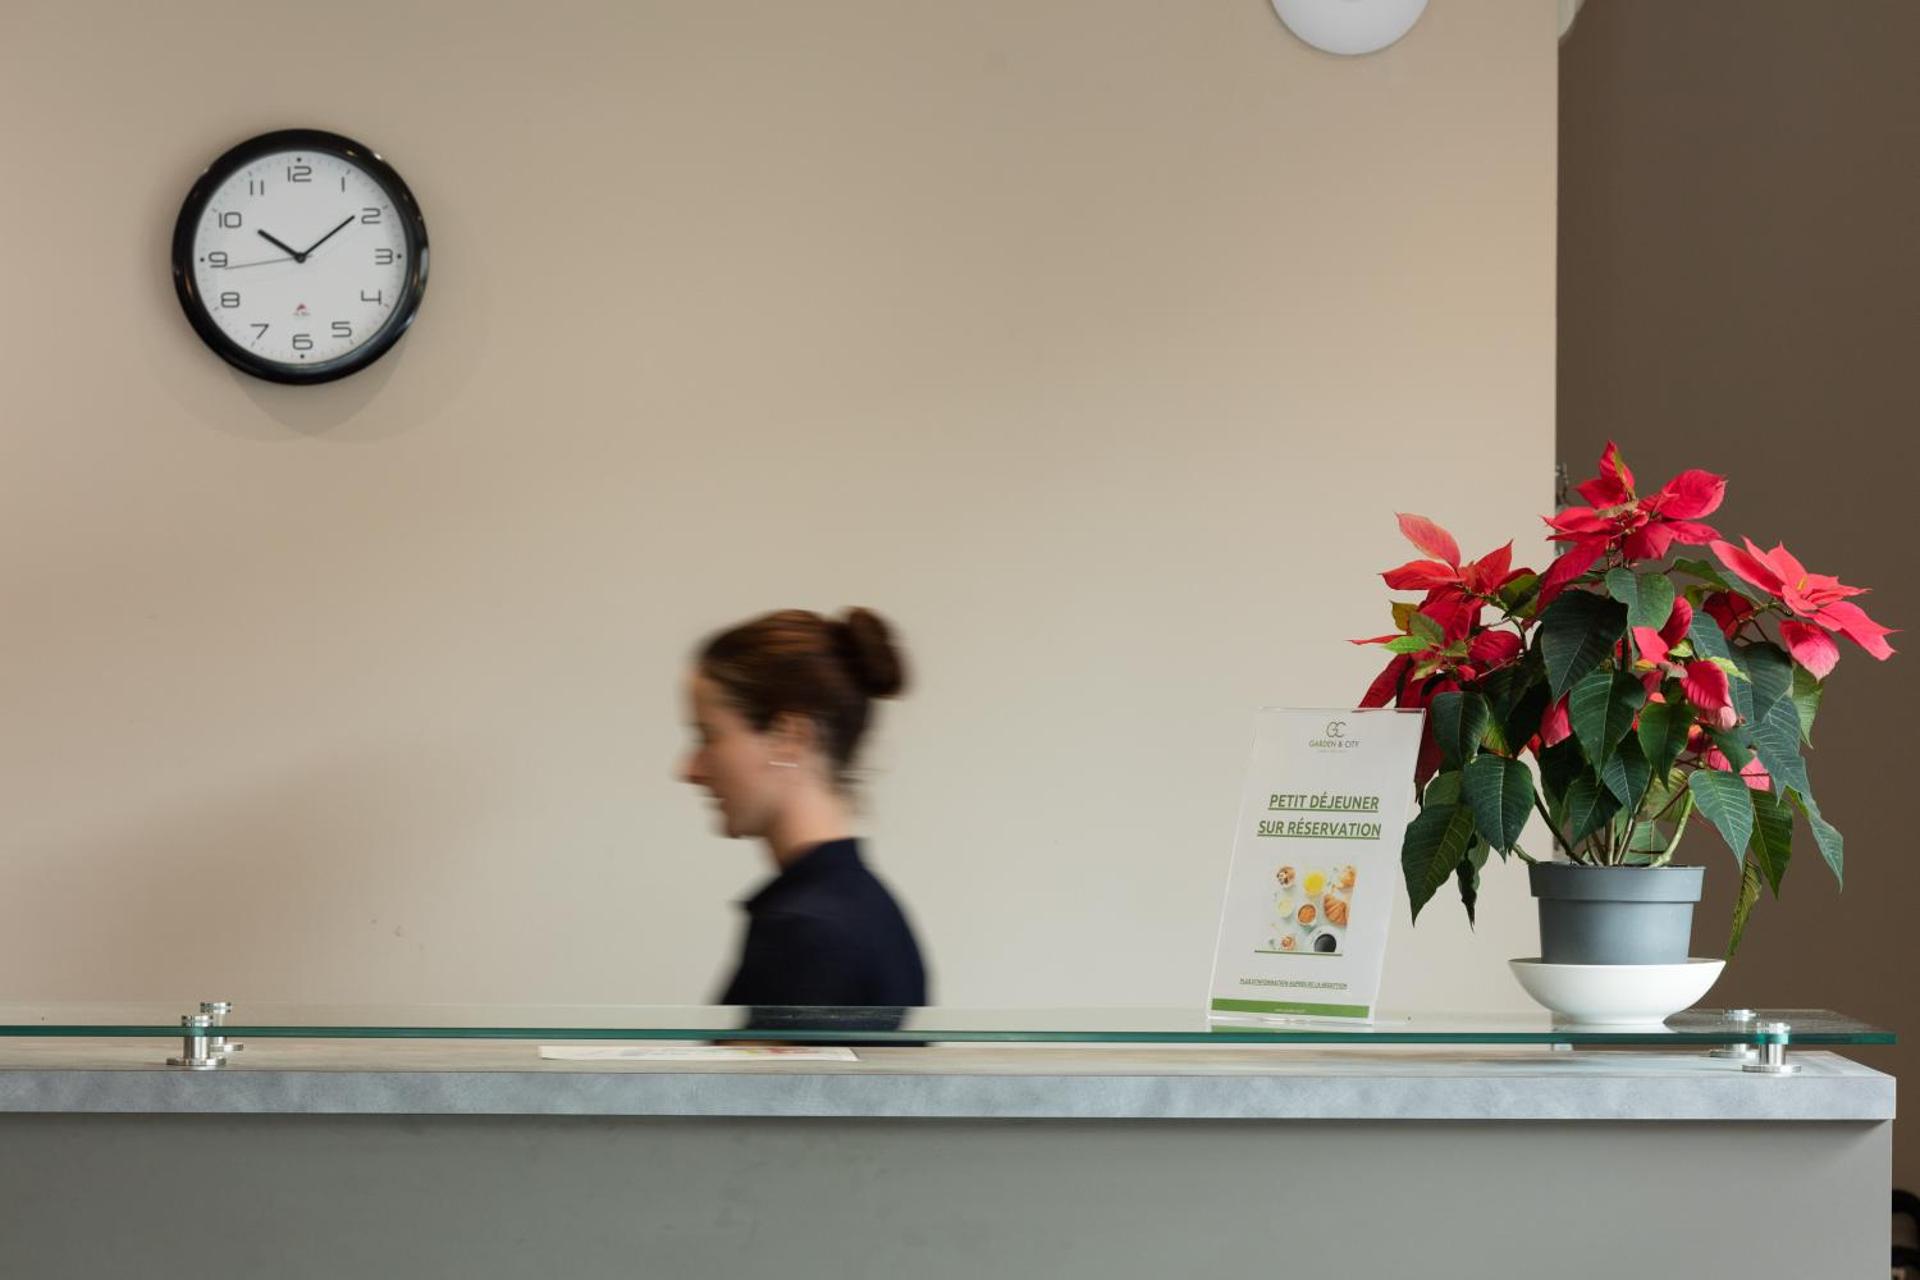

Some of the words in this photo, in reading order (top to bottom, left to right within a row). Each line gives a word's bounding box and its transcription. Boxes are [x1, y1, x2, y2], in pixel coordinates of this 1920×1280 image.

[287, 166, 312, 183] 12
[250, 180, 265, 196] 11
[218, 212, 242, 229] 10
[361, 207, 381, 224] 2
[208, 251, 228, 269] 9
[375, 248, 393, 266] 3
[220, 292, 240, 309] 8
[360, 289, 382, 306] 4
[250, 323, 269, 340] 7
[331, 321, 352, 338] 5
[292, 334, 313, 350] 6
[1269, 794, 1308, 809] PETIT
[1311, 791, 1380, 810] DÉJEUNER
[1257, 820, 1284, 835] SUR
[1287, 817, 1382, 837] RÉSERVATION
